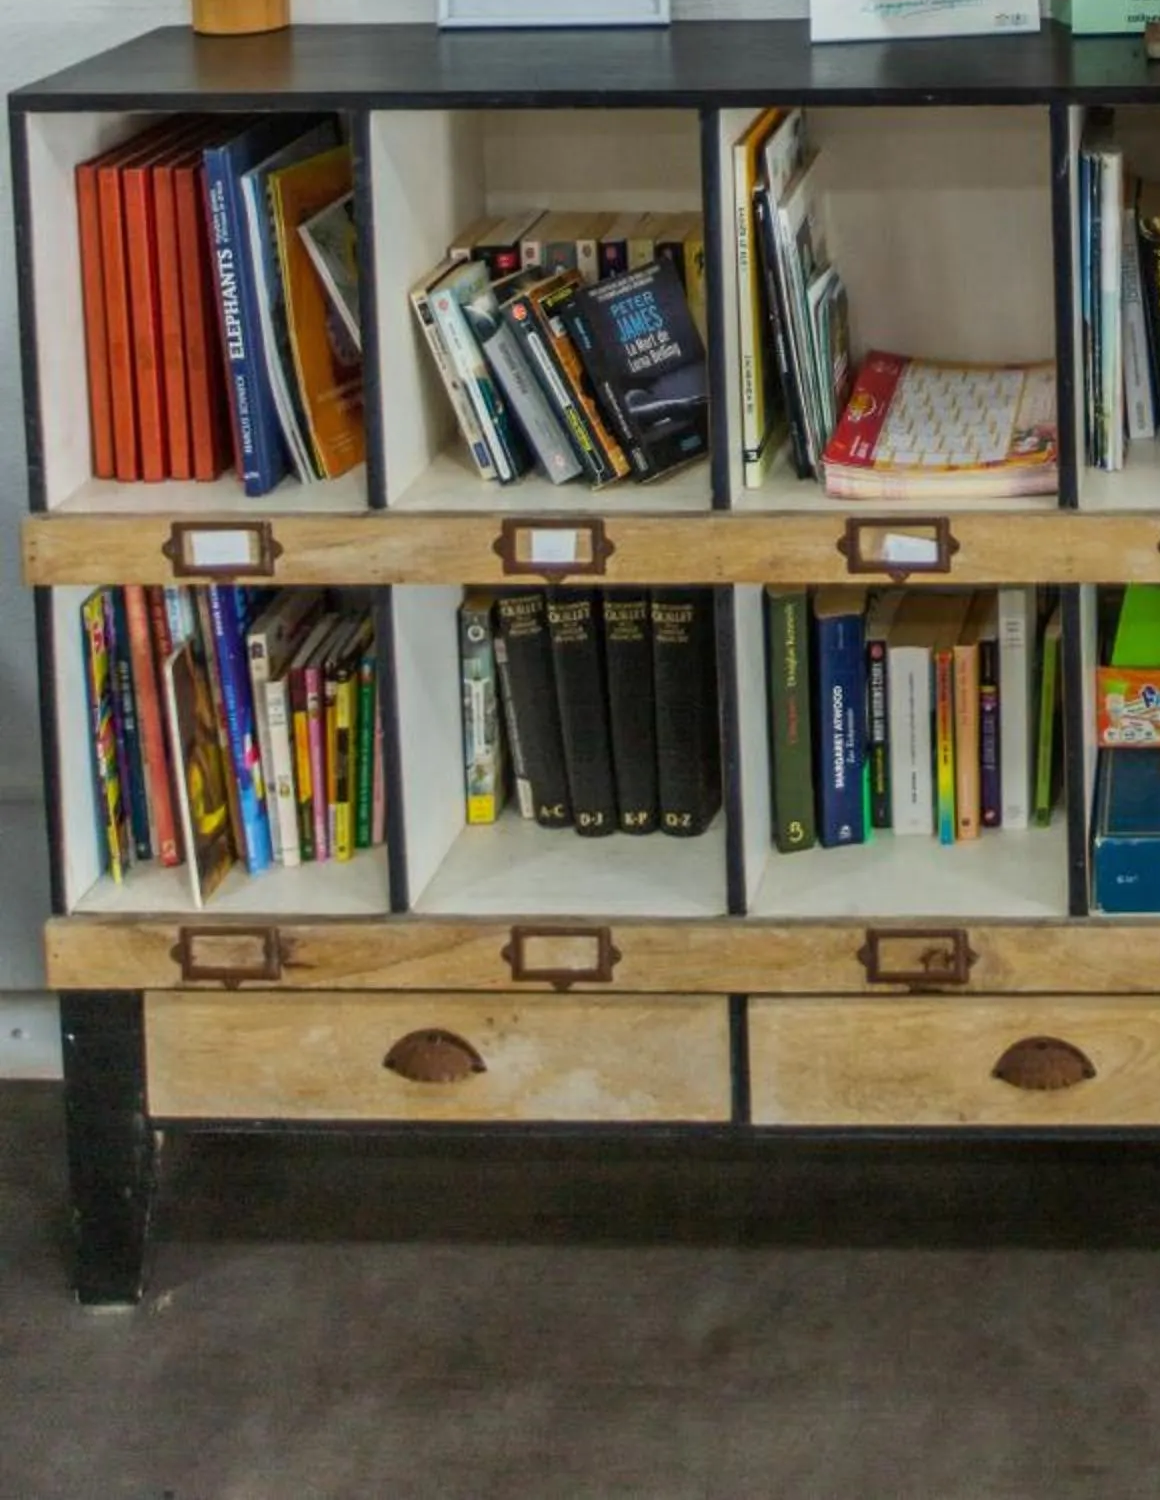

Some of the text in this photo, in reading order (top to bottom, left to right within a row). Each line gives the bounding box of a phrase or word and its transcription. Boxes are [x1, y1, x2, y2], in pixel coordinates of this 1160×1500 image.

[214, 247, 246, 361] ELEPHANTS
[610, 291, 654, 318] PETER
[616, 304, 663, 342] JAMES
[831, 685, 846, 789] MARGARET ATWOOD
